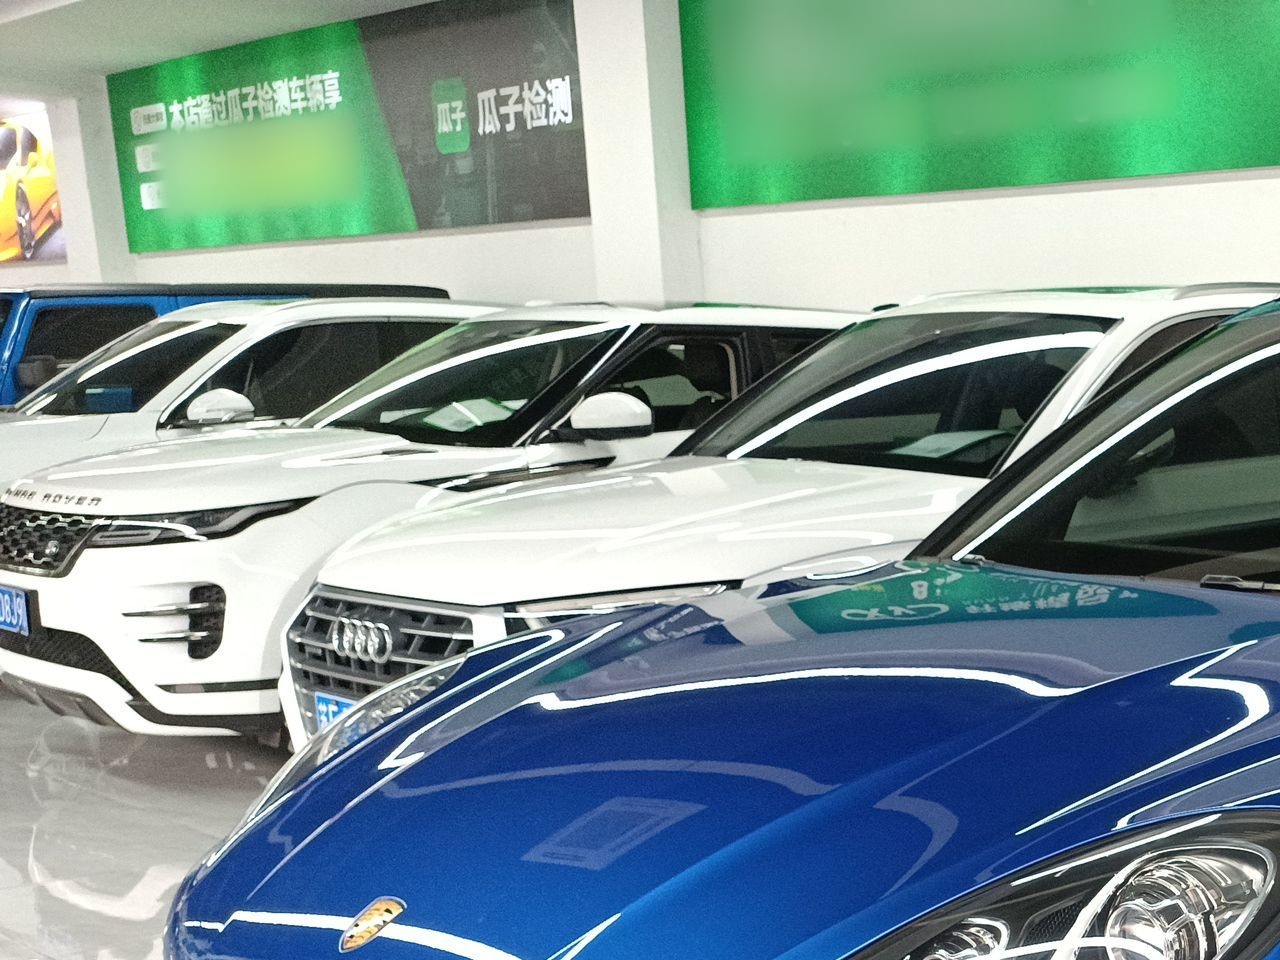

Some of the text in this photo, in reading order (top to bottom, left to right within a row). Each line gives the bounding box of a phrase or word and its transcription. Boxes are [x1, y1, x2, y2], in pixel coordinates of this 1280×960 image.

[437, 101, 466, 134] 瓜子
[477, 75, 573, 136] 瓜子检测
